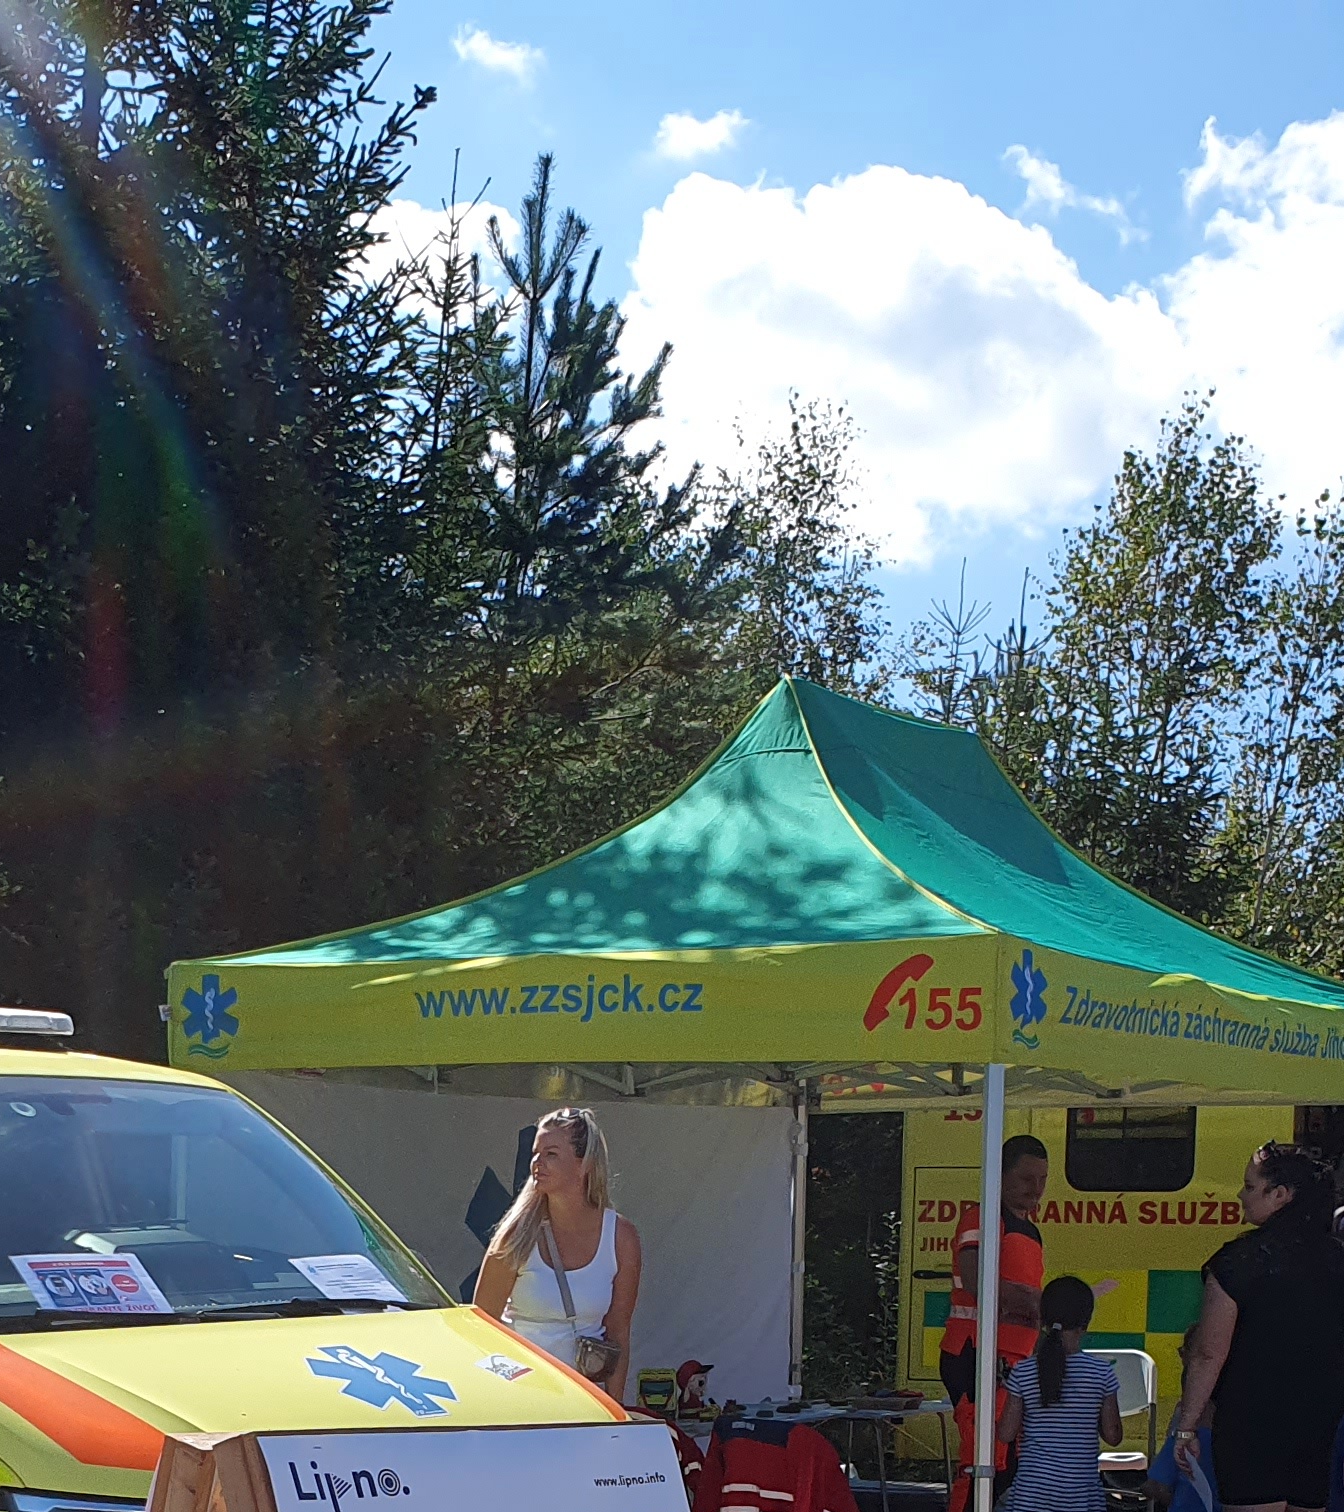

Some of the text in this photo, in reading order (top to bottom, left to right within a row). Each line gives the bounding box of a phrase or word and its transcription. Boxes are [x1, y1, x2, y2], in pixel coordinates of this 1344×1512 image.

[415, 973, 704, 1023] www.zzsjck.cz
[899, 987, 983, 1031] 155
[1059, 985, 1181, 1039] Zdravotnická
[1183, 1003, 1269, 1050] záchranná
[1269, 1021, 1321, 1058] služba
[1138, 1192, 1247, 1226] SLUŽB
[594, 1472, 665, 1487] www.lipno.info
